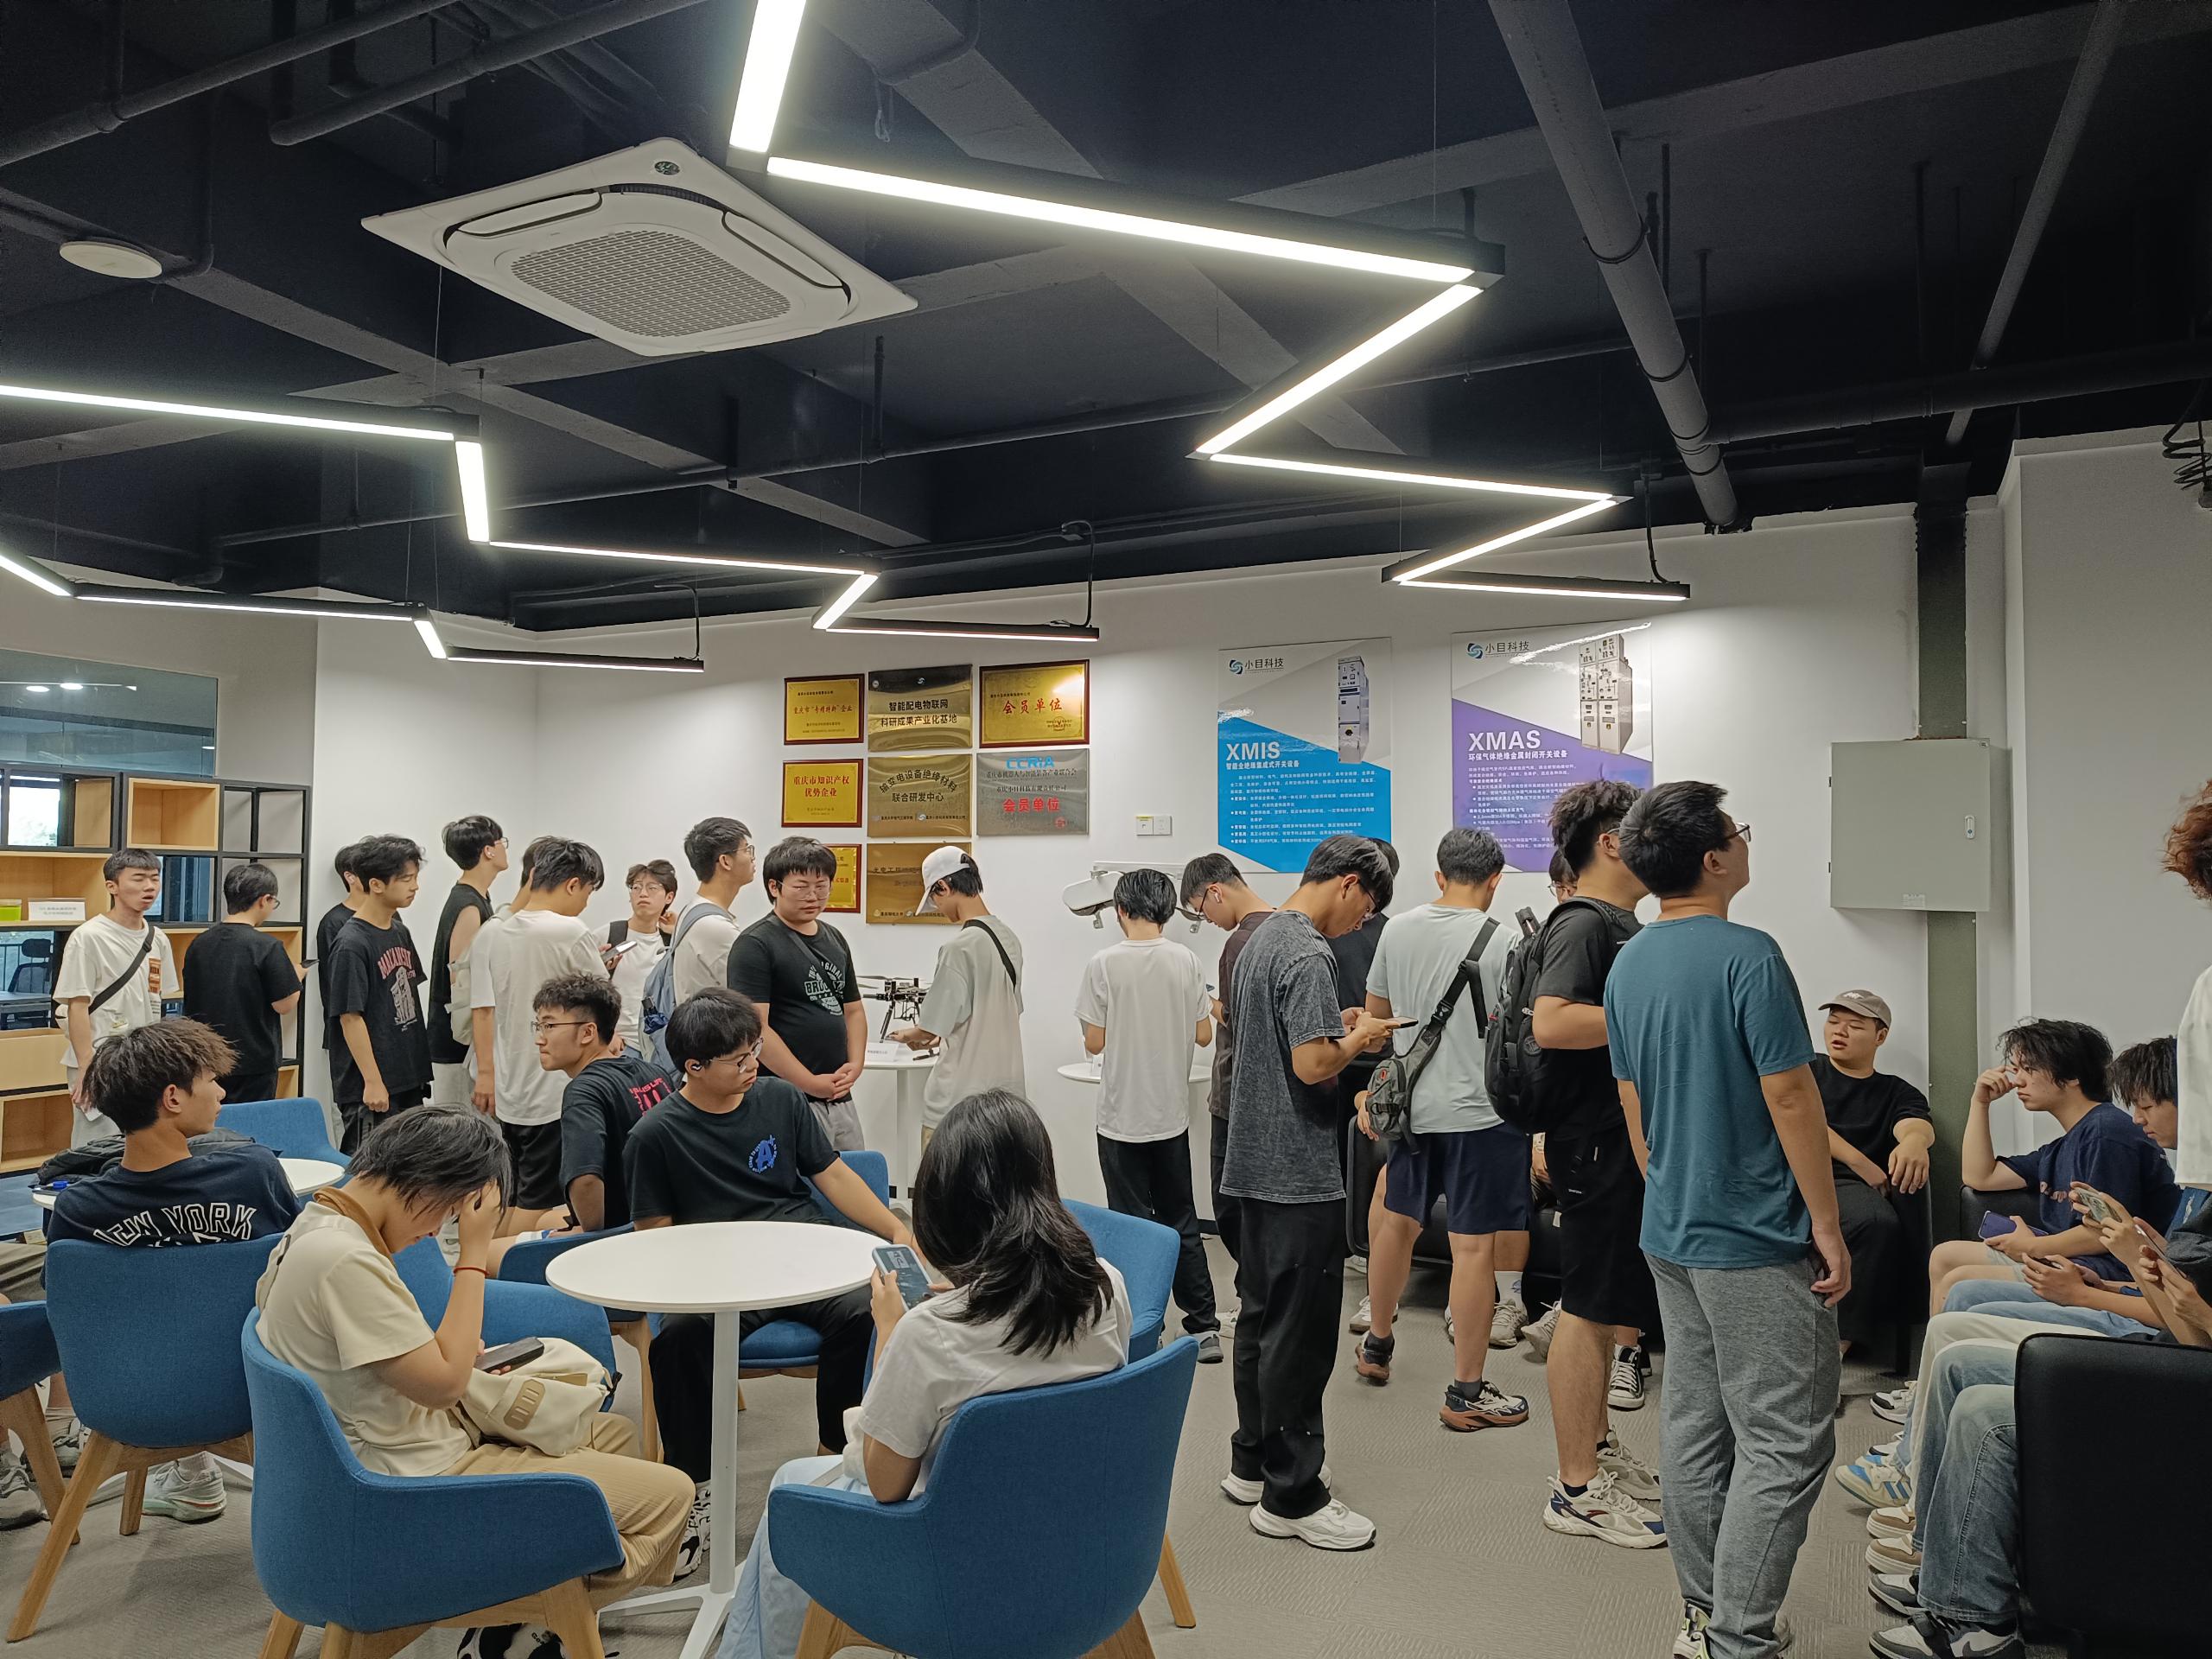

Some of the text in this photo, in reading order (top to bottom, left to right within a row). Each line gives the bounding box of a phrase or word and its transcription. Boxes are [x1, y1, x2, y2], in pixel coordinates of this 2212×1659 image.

[1485, 641, 1529, 653] 小目科技
[1245, 658, 1284, 669] 小目科技
[888, 698, 949, 711] 智能配电物联网
[1002, 697, 1063, 715] 会员单位
[880, 713, 957, 727] 科研成果产业化基地
[1468, 729, 1541, 752] XMAS
[1225, 741, 1281, 761] XMIS
[1468, 749, 1568, 761] 环保气体绝缘金属封闭开关设备
[793, 775, 850, 785] 重庆市知识产权
[879, 768, 957, 793] 输变电设备绝缘材料
[804, 787, 837, 798] 优势企业
[892, 792, 944, 803] 联合研发中心
[1003, 797, 1060, 813] 会员单位
[161, 1202, 257, 1241] YORK
